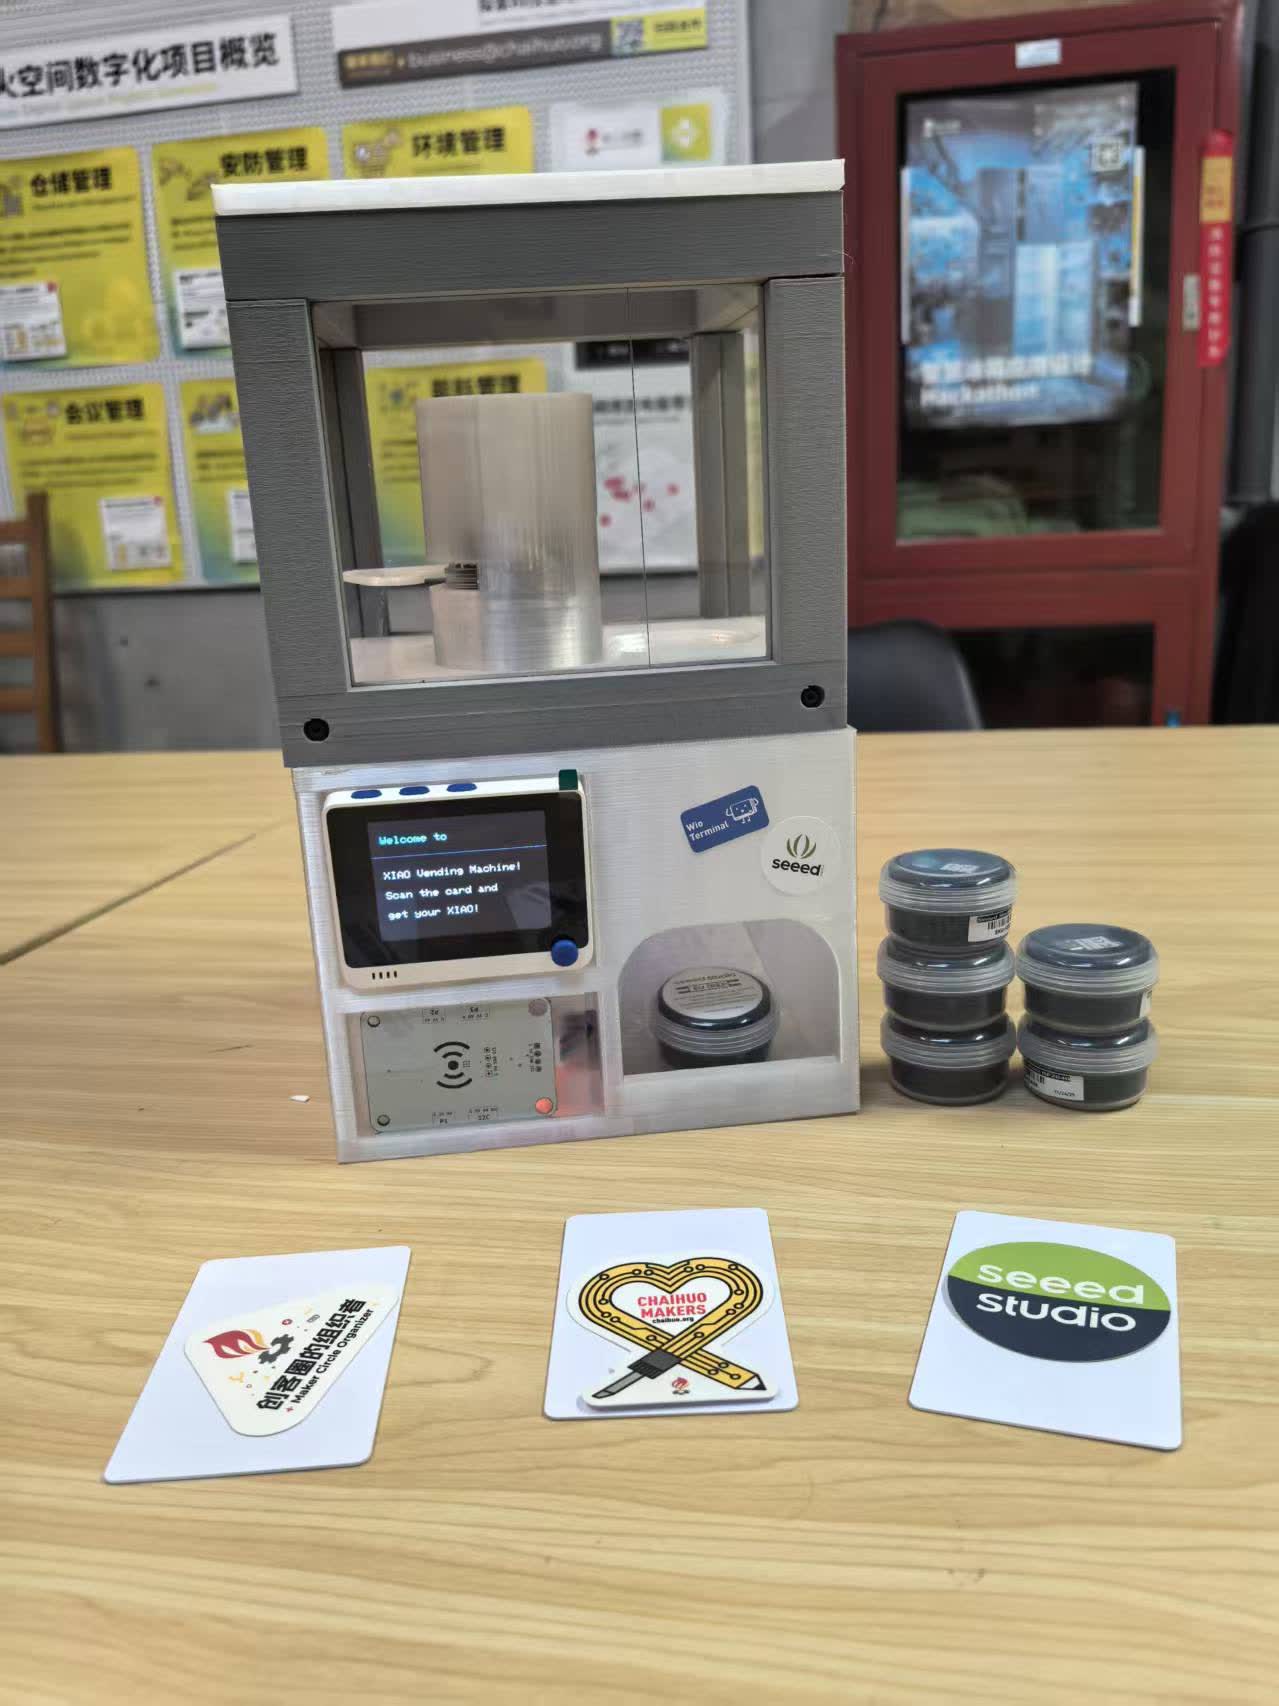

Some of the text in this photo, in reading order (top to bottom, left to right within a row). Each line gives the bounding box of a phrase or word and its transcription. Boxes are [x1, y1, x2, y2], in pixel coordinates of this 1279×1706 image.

[411, 126, 506, 158] 环境管理
[220, 146, 309, 178] 安防管理
[30, 167, 112, 198] 仓储管理
[65, 398, 145, 425] 会议管理
[685, 821, 704, 832] Wio
[689, 821, 729, 841] Terminal
[378, 832, 448, 846] Welcome to
[383, 861, 521, 880] XIAO Vending Machine!
[772, 858, 821, 876] seeed
[385, 883, 499, 901] Scan the card and
[388, 904, 479, 921] get your XIAO!
[977, 1264, 1144, 1304] seeed
[637, 1292, 708, 1307] CHAIHUO
[640, 1304, 707, 1318] MAKERS
[976, 1293, 1137, 1332] studio
[256, 1298, 367, 1411] 创客圈的组织者
[293, 1308, 374, 1404] Maker Circle Organizer
